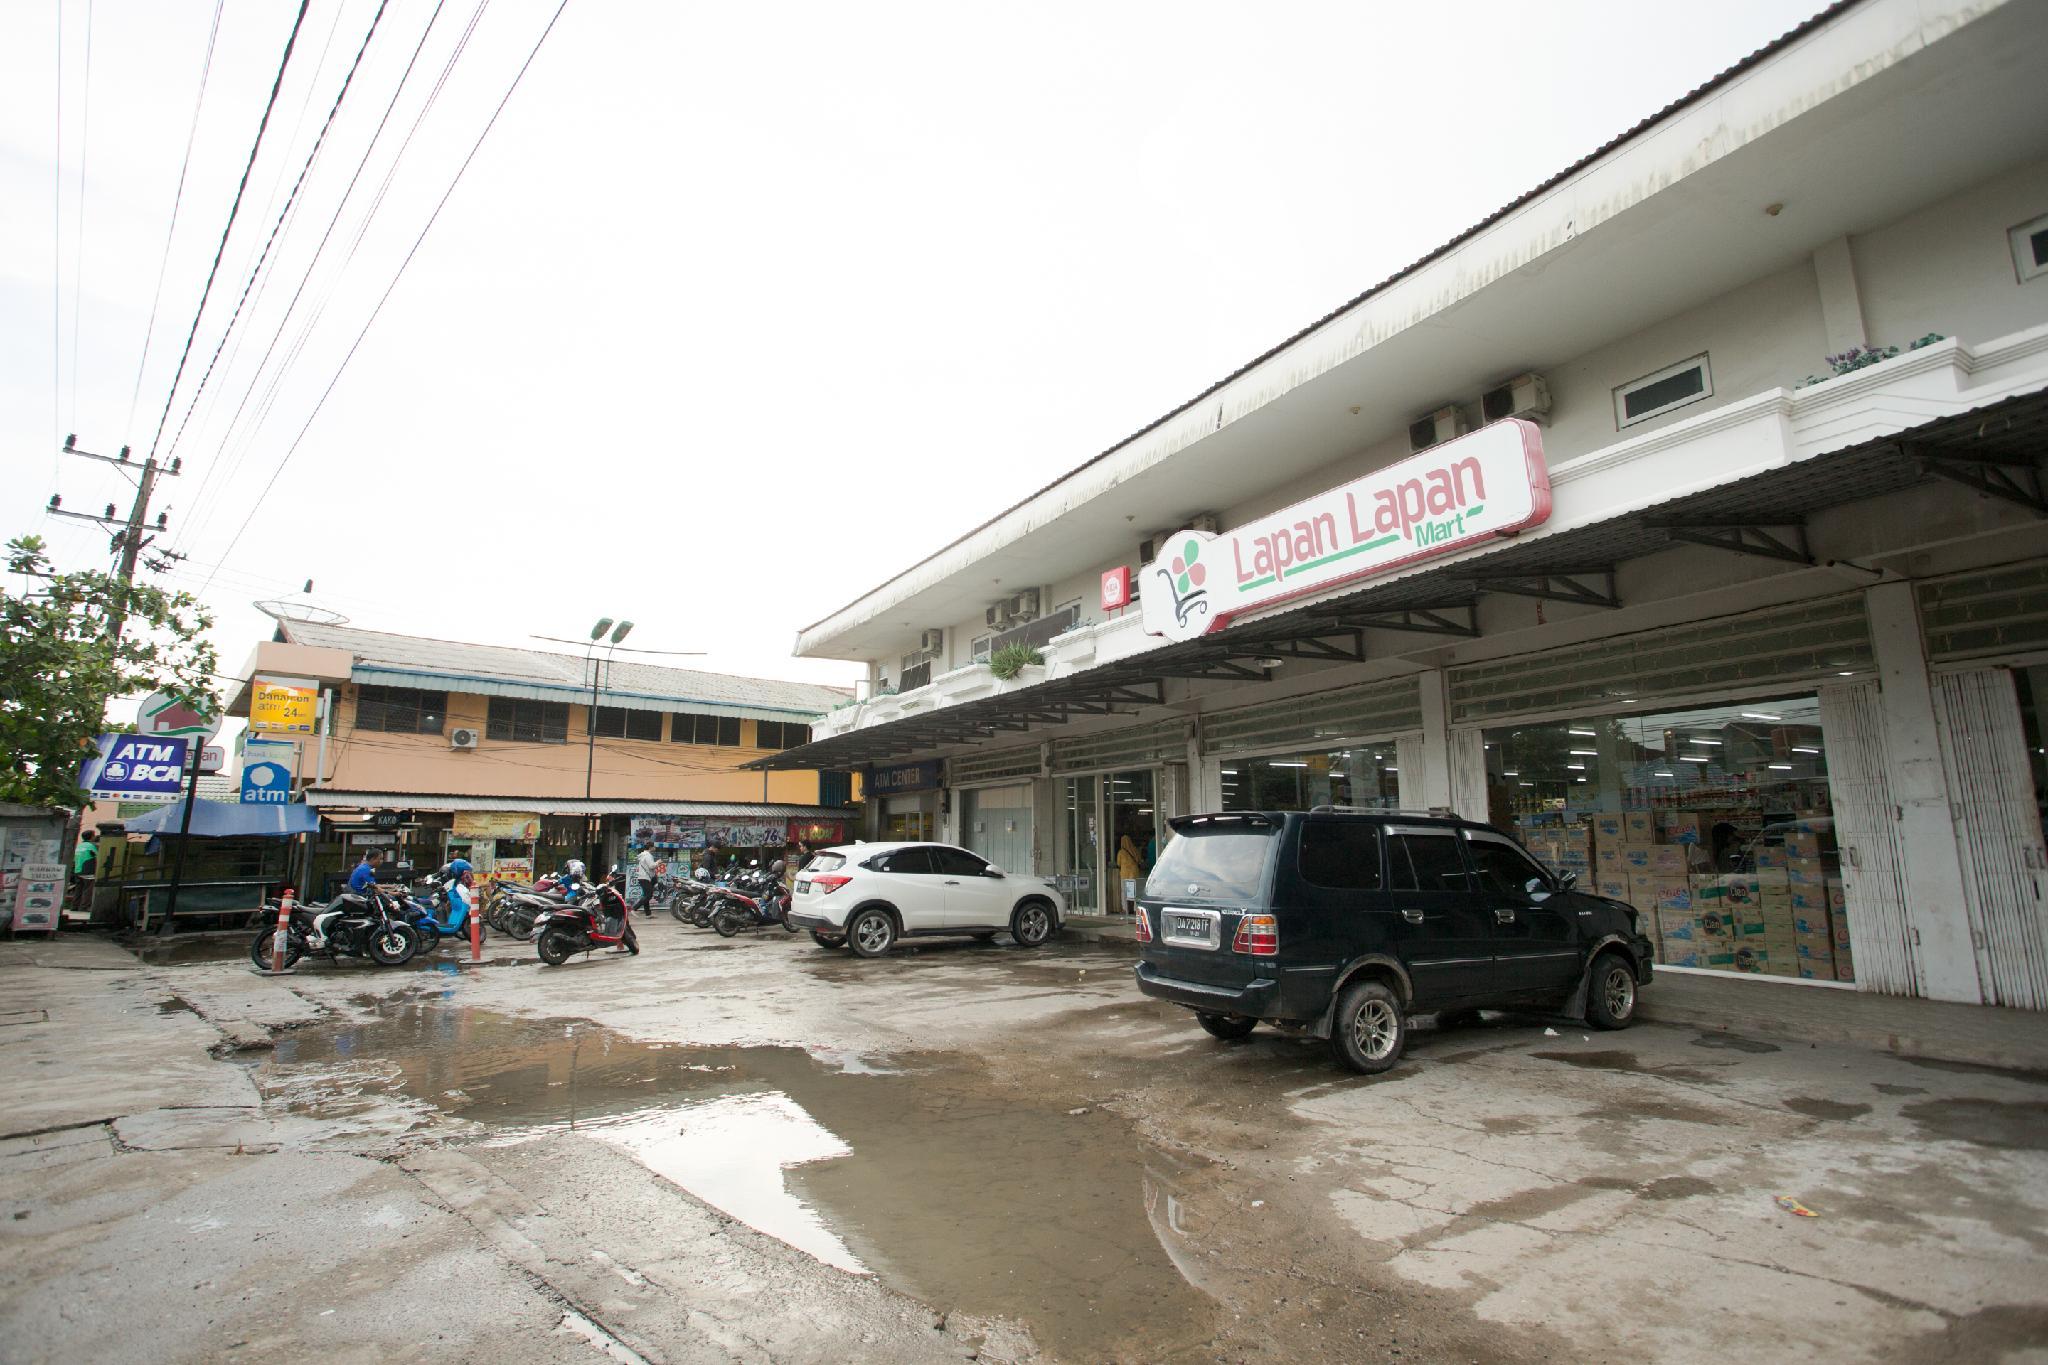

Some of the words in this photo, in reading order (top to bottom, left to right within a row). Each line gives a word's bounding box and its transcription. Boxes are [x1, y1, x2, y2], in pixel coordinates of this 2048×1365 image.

[1232, 511, 1339, 583] Lapan
[1345, 456, 1487, 544] Lapan
[1414, 512, 1466, 548] Mart
[283, 707, 298, 718] 24
[115, 743, 175, 762] ATM
[130, 764, 182, 782] BCA
[891, 767, 921, 786] CENTER
[244, 787, 285, 802] atm
